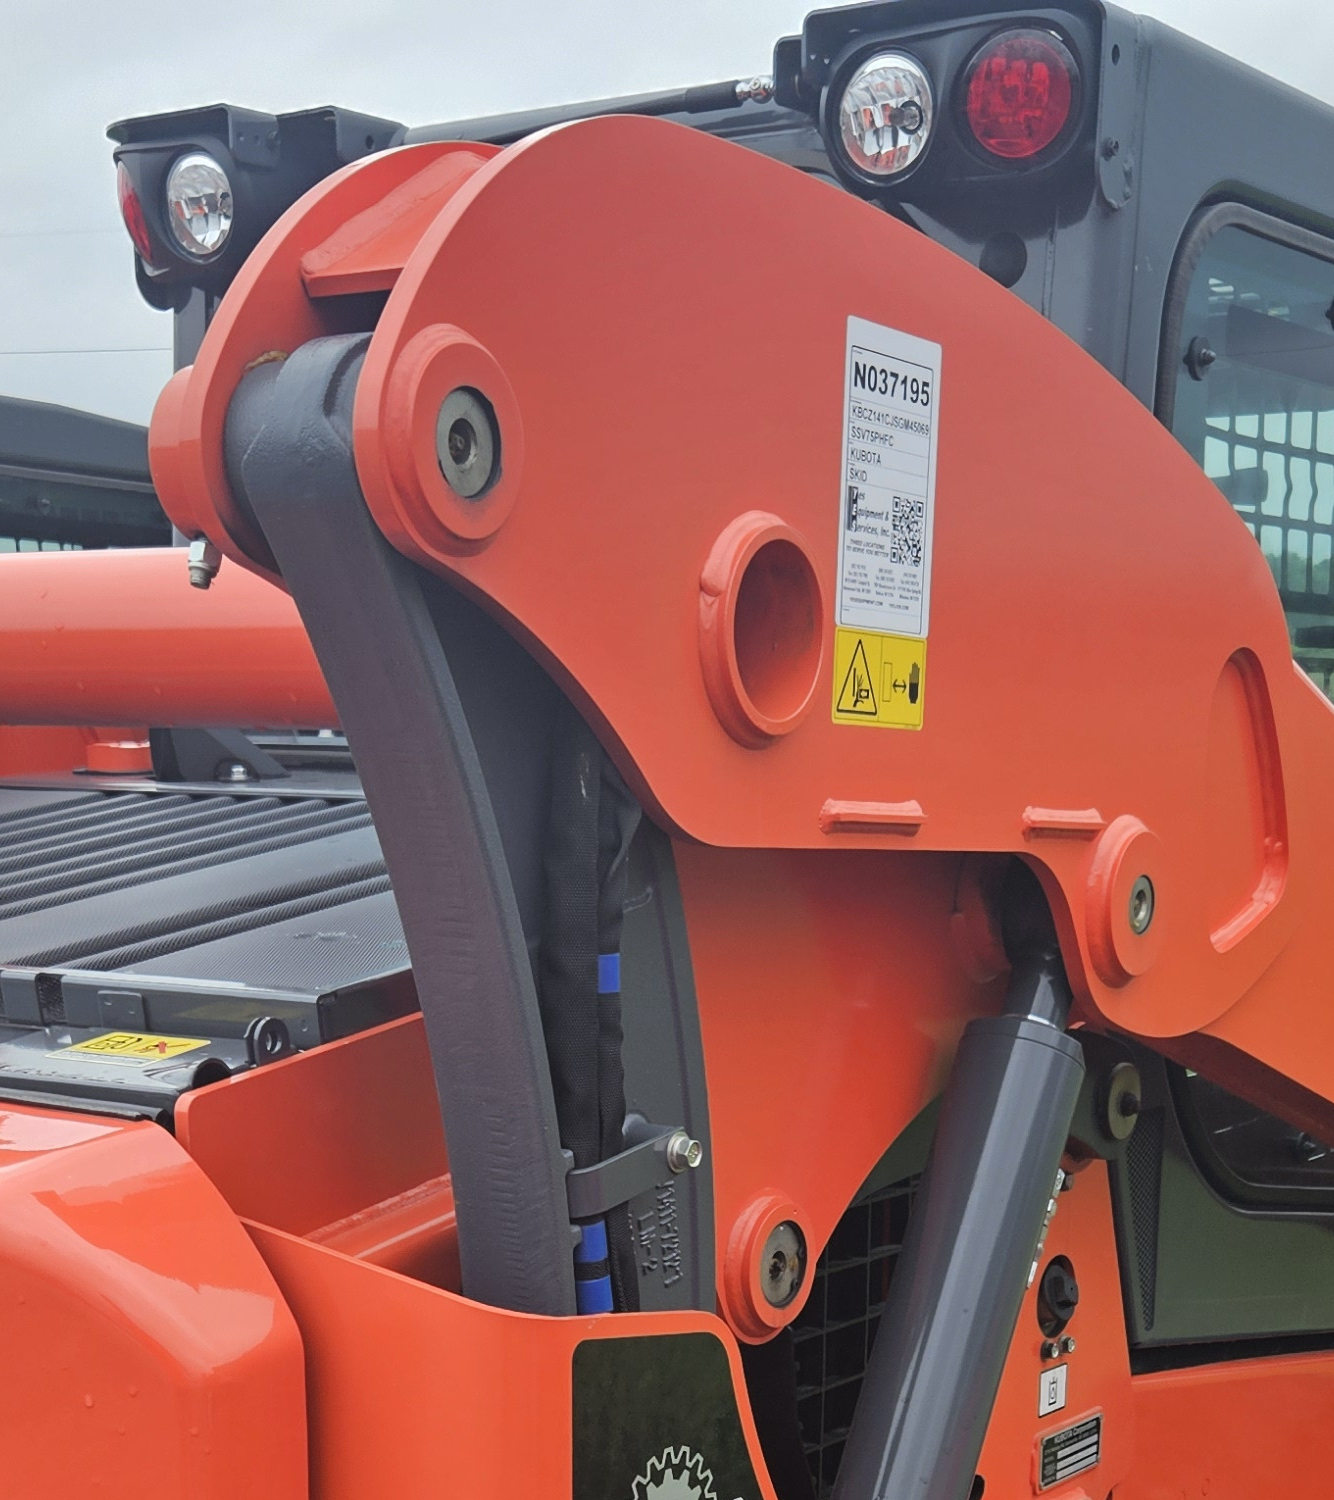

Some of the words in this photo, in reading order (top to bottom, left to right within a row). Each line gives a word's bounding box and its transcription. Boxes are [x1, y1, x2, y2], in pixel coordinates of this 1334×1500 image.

[854, 361, 930, 407] N037195
[851, 426, 894, 447] SSV75PHFC
[850, 448, 882, 465] KUBOTA
[849, 467, 867, 482] SKID
[851, 503, 884, 521] Equipment
